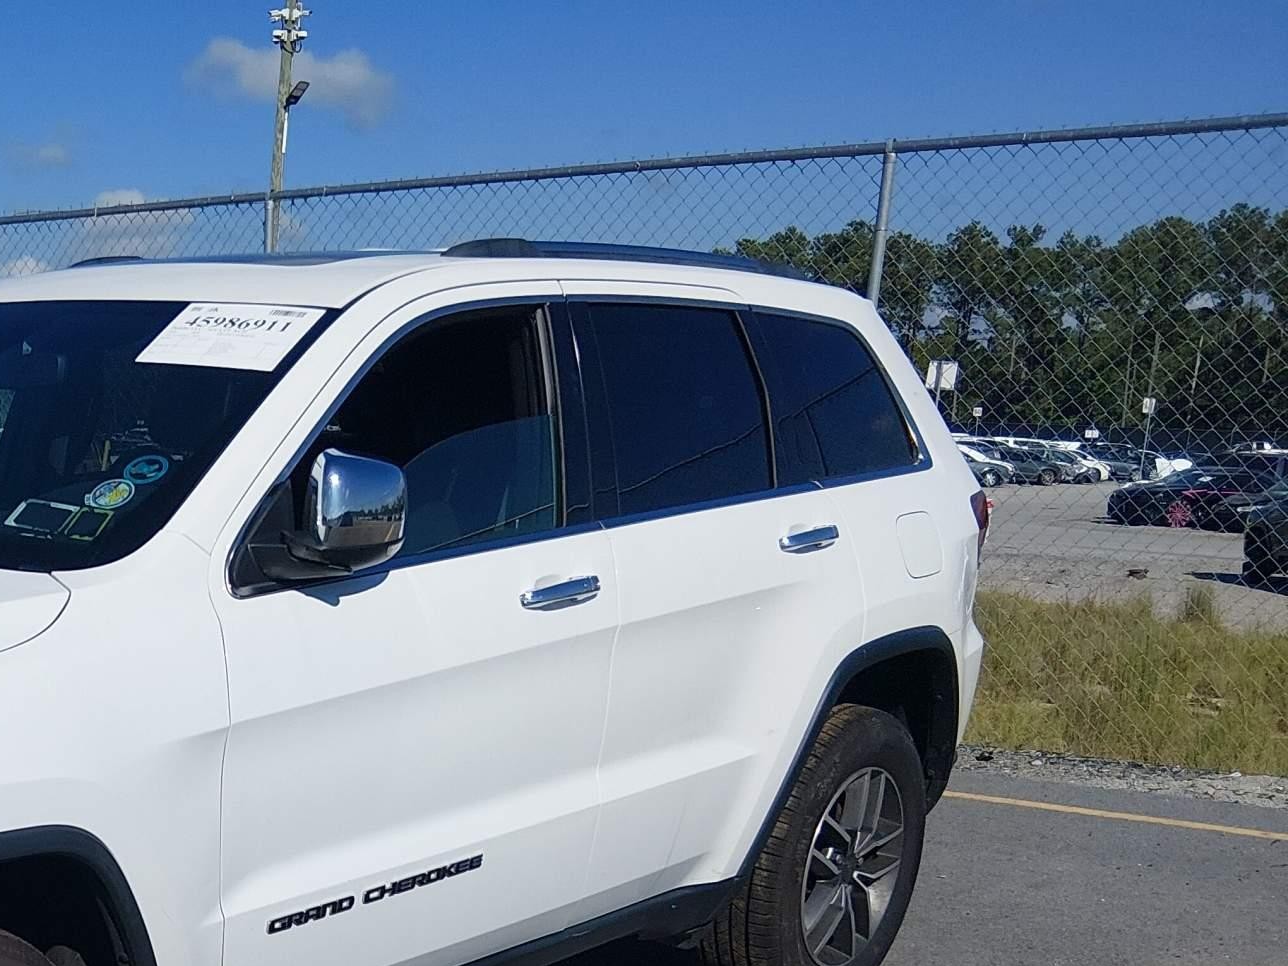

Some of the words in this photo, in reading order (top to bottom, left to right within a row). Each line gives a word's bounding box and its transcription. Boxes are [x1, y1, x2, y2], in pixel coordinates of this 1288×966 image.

[185, 315, 292, 332] 45986911
[267, 895, 355, 935] GRAND
[362, 853, 484, 904] CHEROKEE
